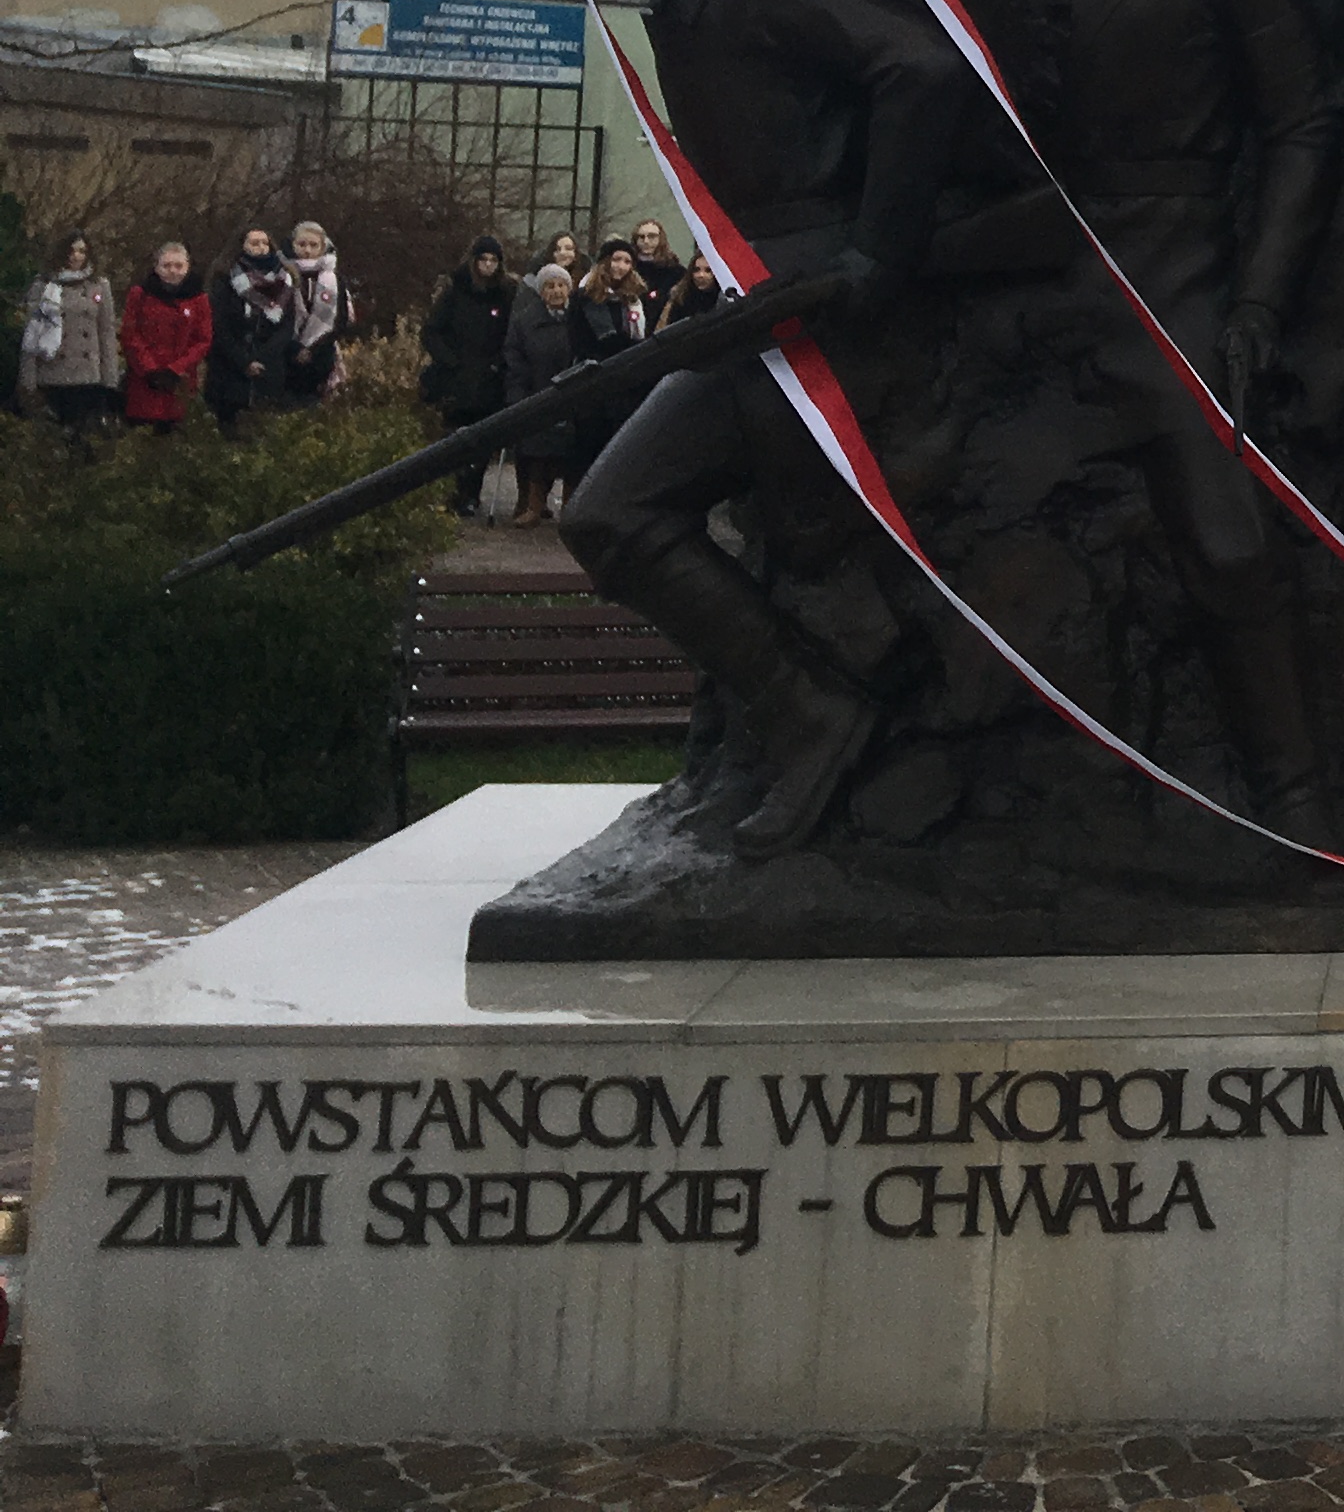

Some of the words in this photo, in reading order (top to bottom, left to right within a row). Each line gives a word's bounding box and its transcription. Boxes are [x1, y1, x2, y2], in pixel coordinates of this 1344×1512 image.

[105, 1070, 730, 1155] POWSTAŃCOM
[99, 1174, 329, 1249] ZIEMI
[364, 1157, 769, 1257] ŚREDZKIEJ
[864, 1160, 1216, 1240] CHWAŁA
